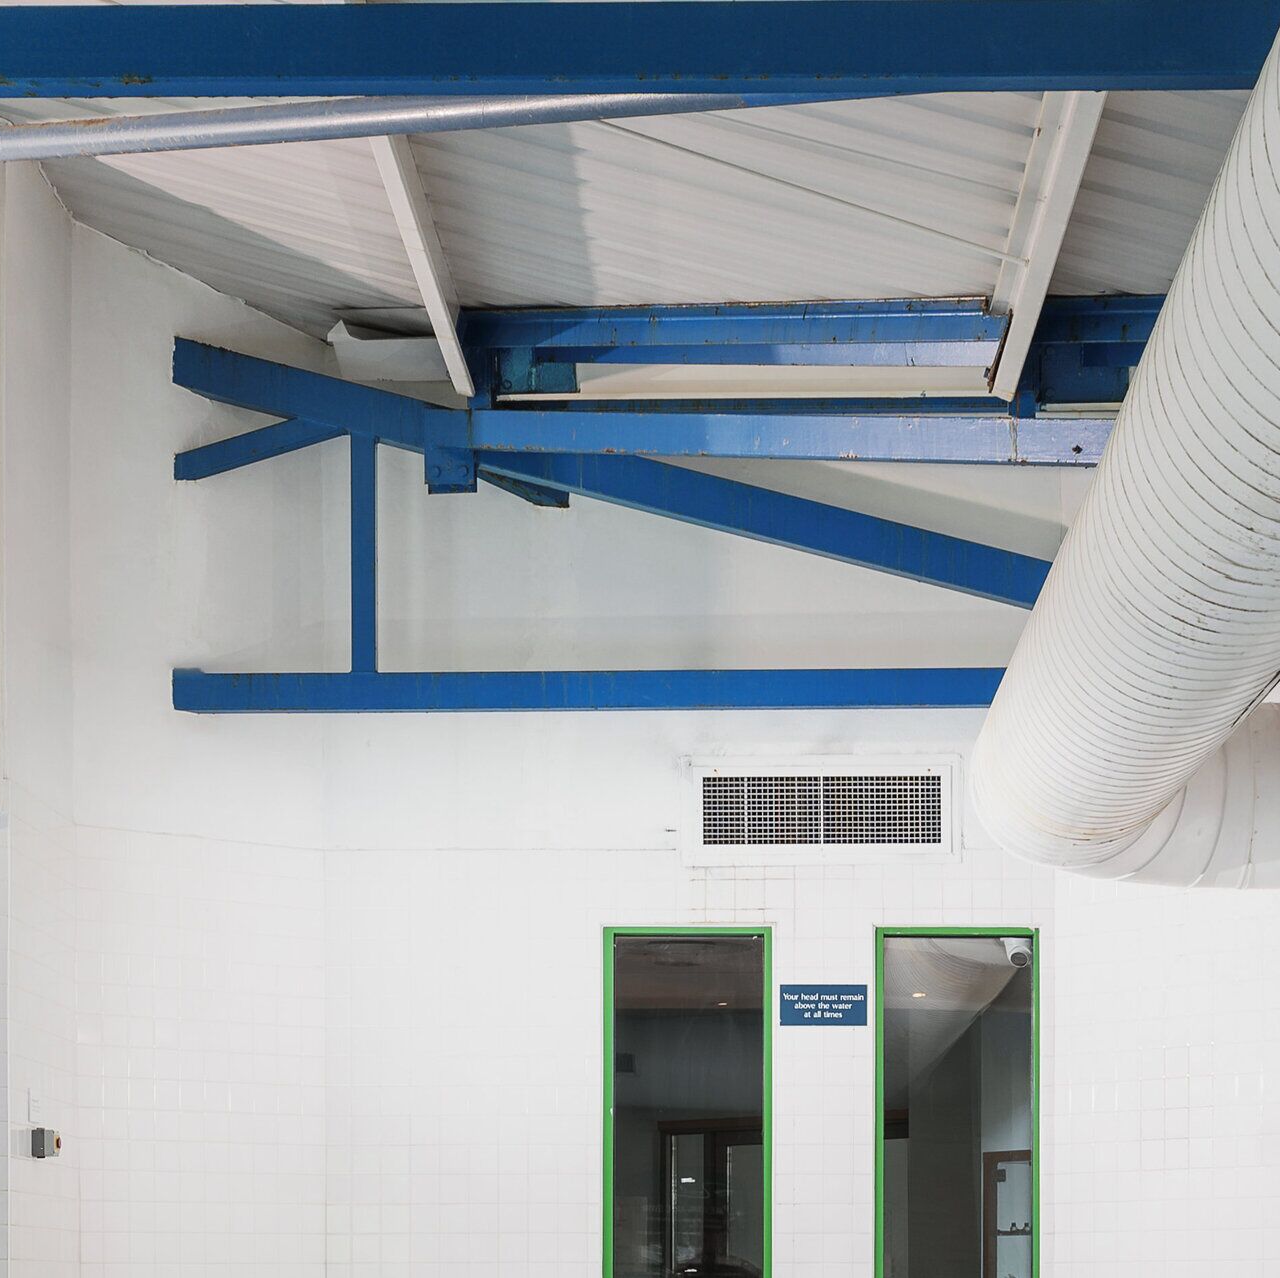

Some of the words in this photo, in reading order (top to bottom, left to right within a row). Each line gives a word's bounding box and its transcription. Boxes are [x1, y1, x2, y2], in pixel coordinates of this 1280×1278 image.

[783, 993, 799, 1001] Your
[801, 993, 818, 1001] head
[840, 993, 864, 1001] remain
